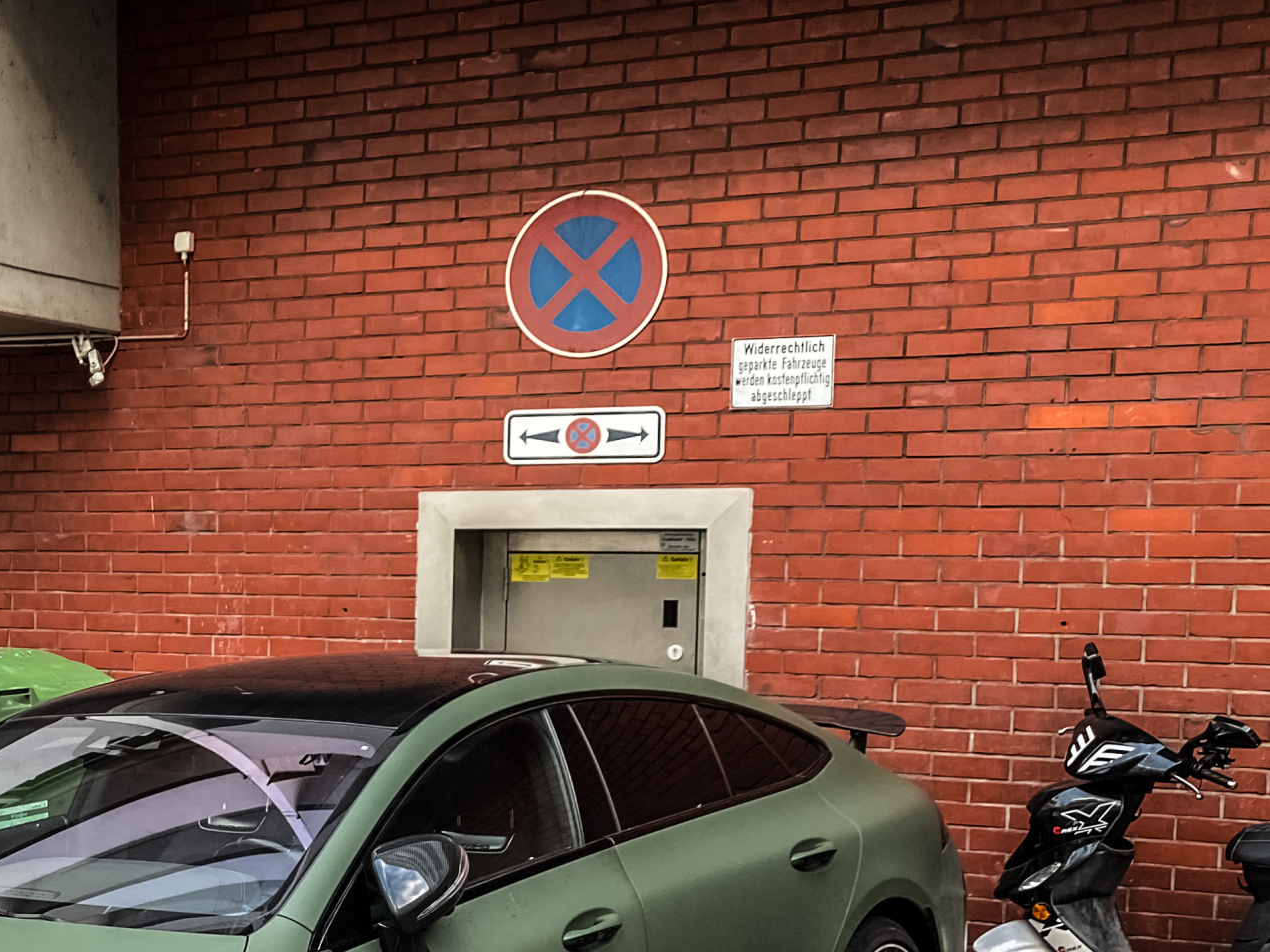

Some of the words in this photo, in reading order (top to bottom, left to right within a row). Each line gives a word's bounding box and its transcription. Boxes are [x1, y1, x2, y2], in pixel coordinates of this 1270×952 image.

[744, 340, 825, 355] Widerrechtlich
[738, 358, 777, 375] geparkte
[781, 357, 827, 372] Fahrzeuge
[735, 374, 765, 386] werden
[767, 372, 830, 388] kostenpflichtig
[751, 388, 812, 404] abgeschleppt
